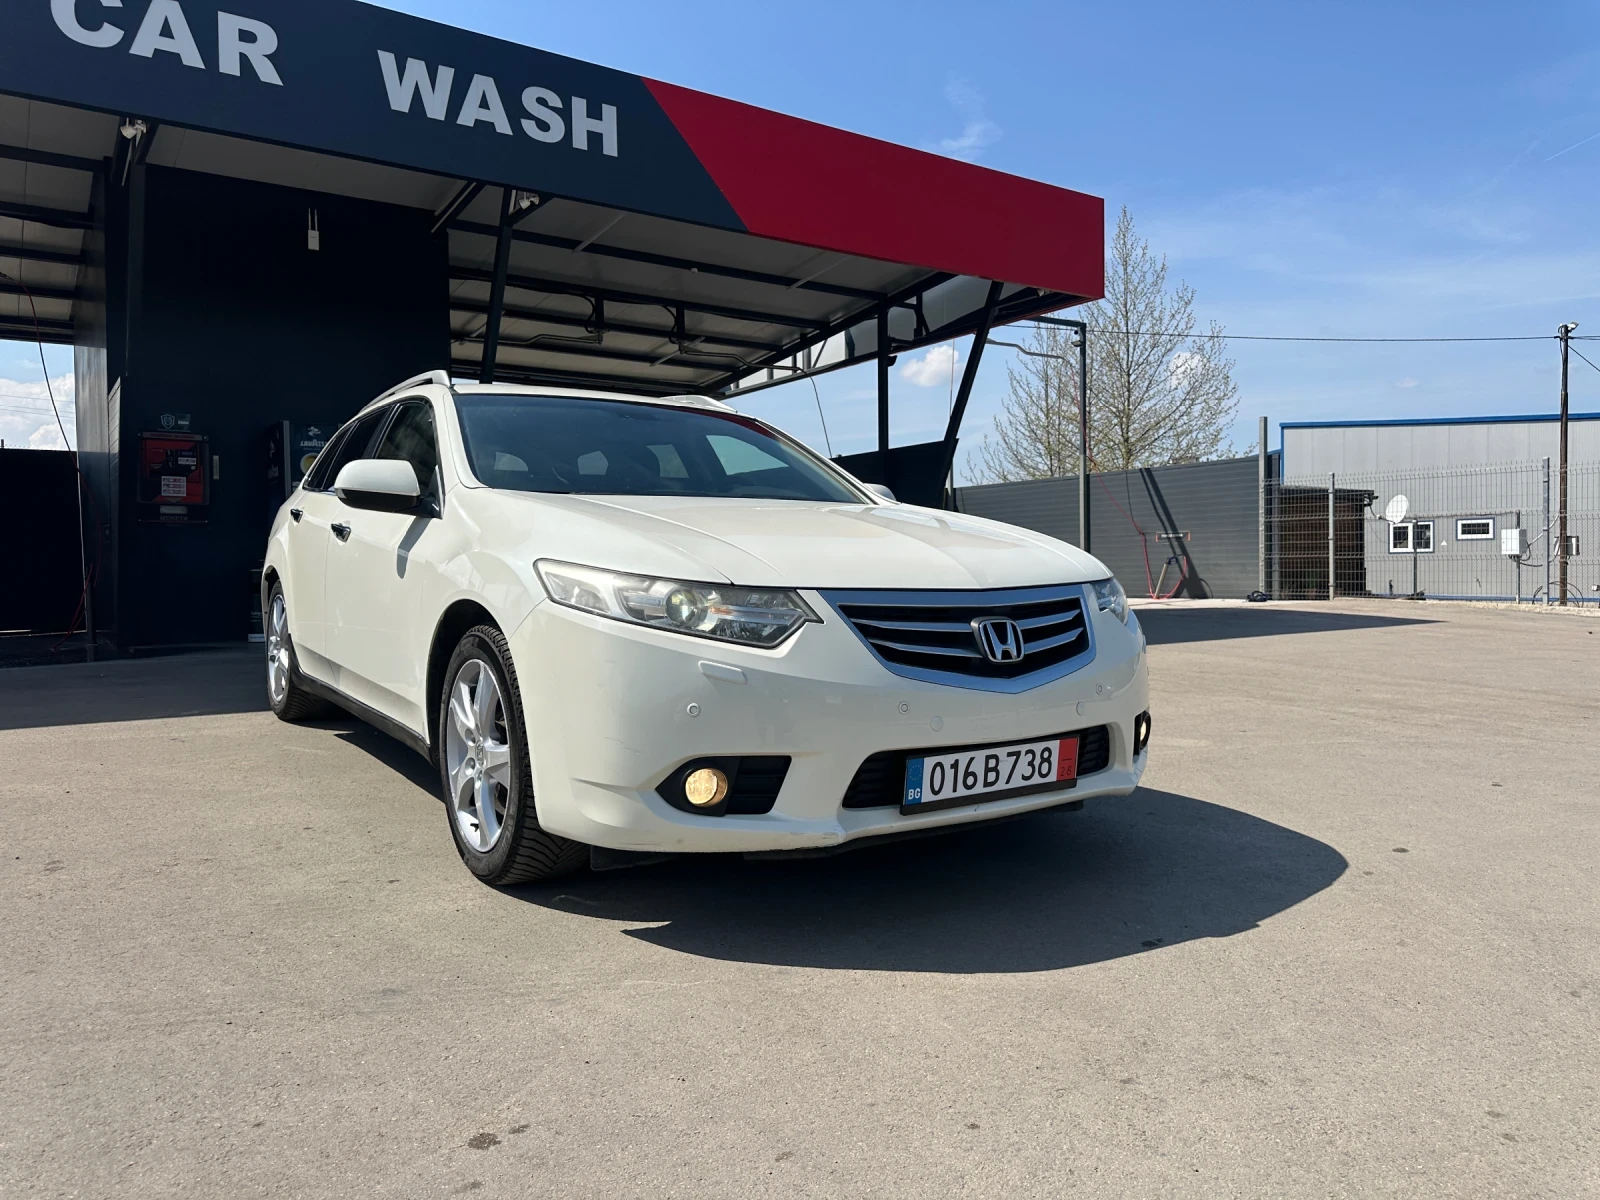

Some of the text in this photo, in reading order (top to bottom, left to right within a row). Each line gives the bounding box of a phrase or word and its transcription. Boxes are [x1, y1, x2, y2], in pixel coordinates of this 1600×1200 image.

[50, 0, 618, 157] CAR WASH
[929, 746, 1053, 796] 016B738
[1060, 765, 1072, 777] 28
[908, 787, 921, 800] BG
